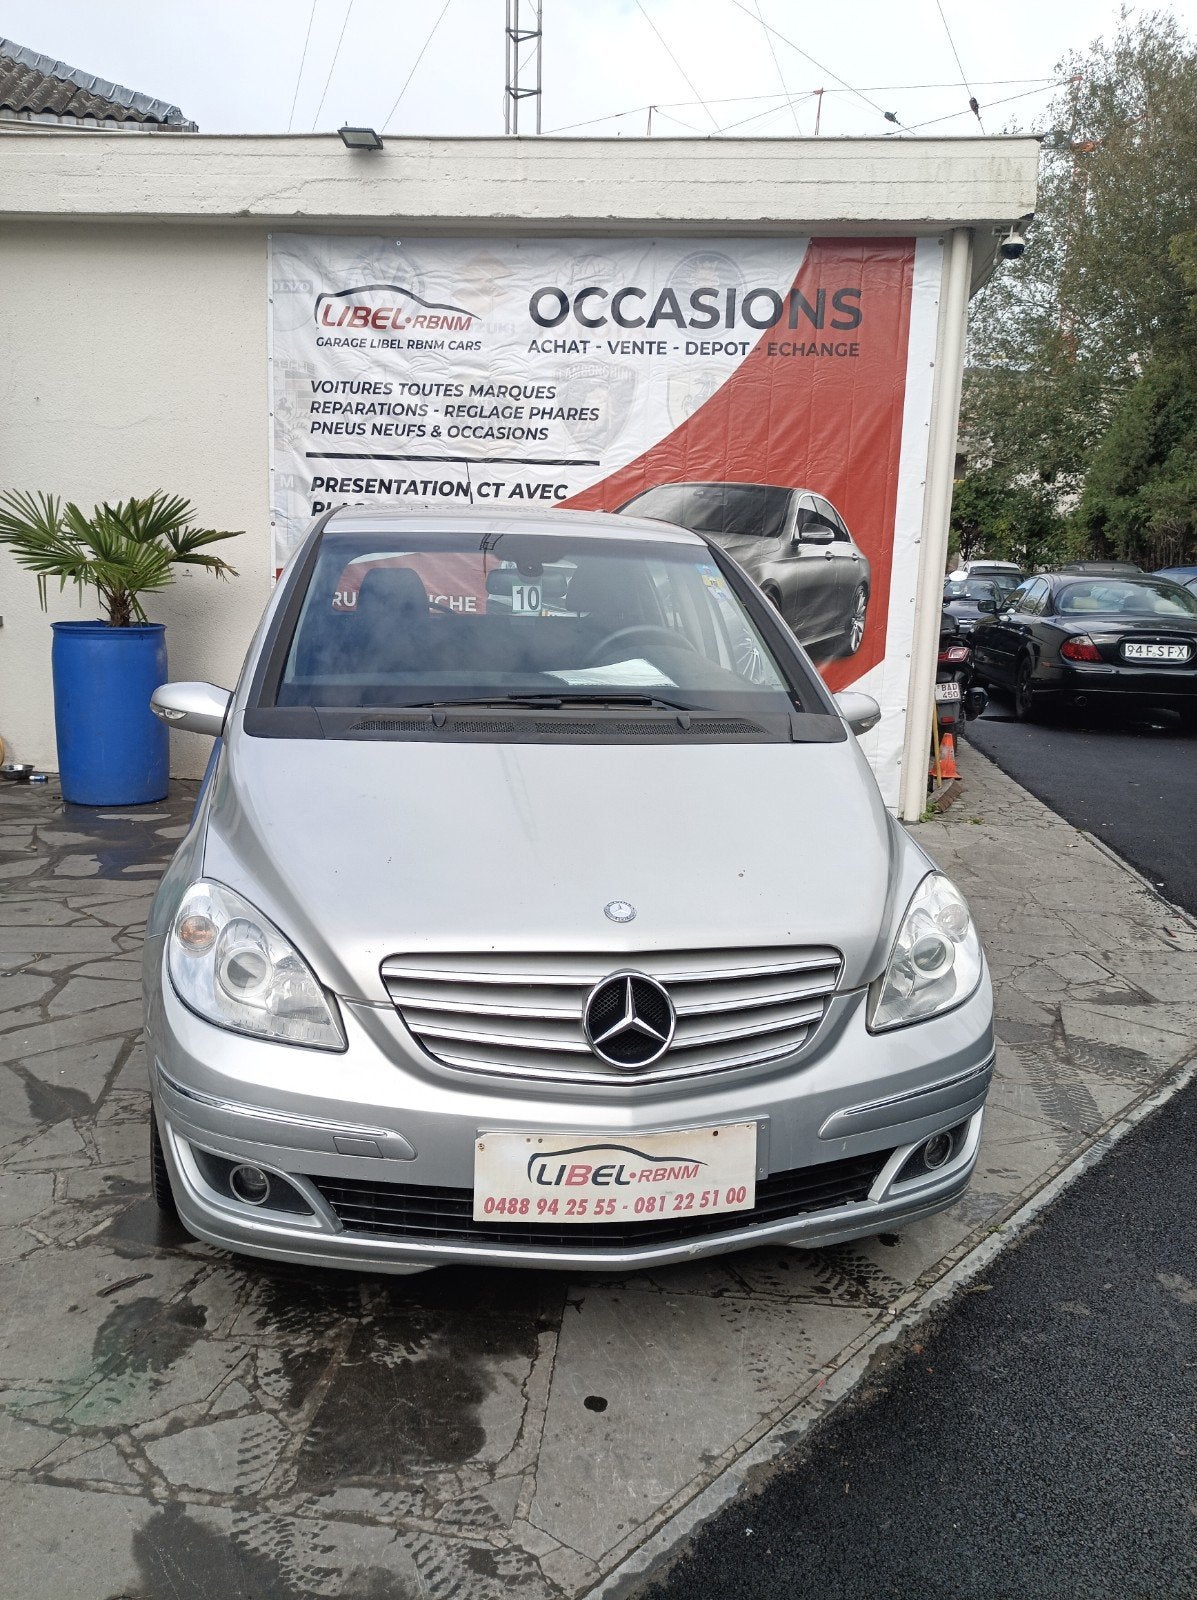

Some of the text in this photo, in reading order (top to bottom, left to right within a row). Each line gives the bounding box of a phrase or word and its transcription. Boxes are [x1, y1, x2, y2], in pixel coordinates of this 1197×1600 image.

[529, 286, 863, 331] OCCASIONS
[316, 336, 482, 351] GARAGE LIBEL RBNM CARS
[528, 340, 591, 354] ACHAT
[607, 341, 668, 355] VENTE
[685, 341, 750, 356] DEPOT
[767, 342, 860, 357] ECHANGE
[310, 380, 557, 401] VOITURES TOUTES MARQUES
[310, 400, 429, 417] REPARATIONS
[444, 404, 525, 419] REGLAGE
[528, 406, 600, 421] PHARES
[310, 421, 550, 441] PNEUS NEUFS & OCCASIONS
[310, 476, 569, 500] PRESENTATION CT AVEC
[516, 586, 540, 611] 10
[483, 1196, 530, 1215] 0488
[536, 1197, 559, 1216] 94
[564, 1198, 588, 1216] 25
[593, 1198, 616, 1216] 55
[633, 1195, 667, 1215] 081
[672, 1192, 695, 1211] 22
[699, 1189, 720, 1209] 51
[725, 1185, 747, 1205] 00
